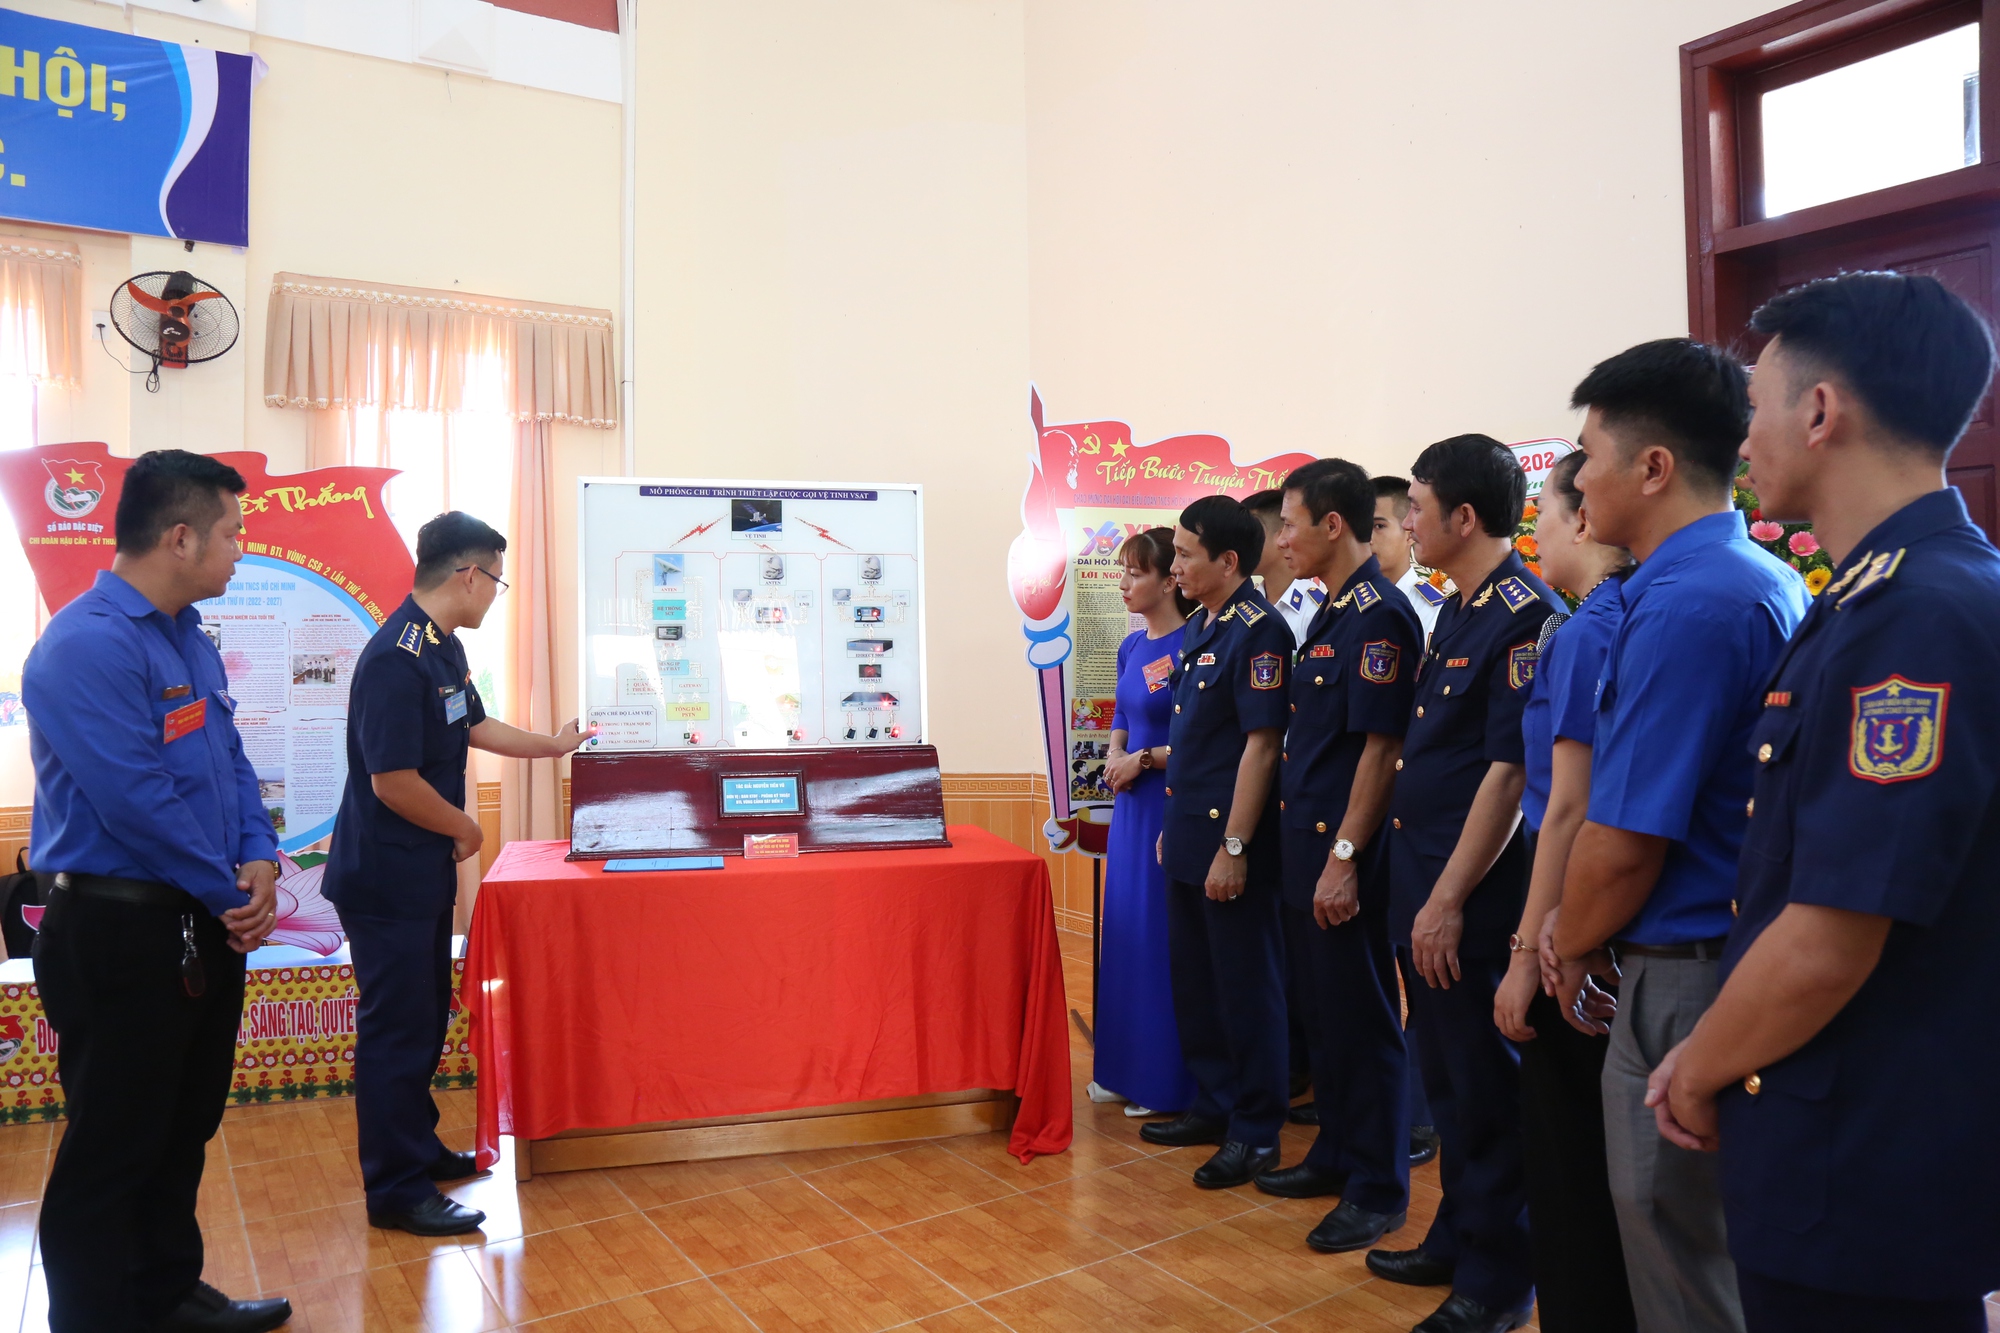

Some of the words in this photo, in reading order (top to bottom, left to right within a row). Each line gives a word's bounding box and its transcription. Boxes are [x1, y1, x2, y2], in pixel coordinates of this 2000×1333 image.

[0, 45, 127, 122] HỘI;
[712, 488, 737, 496] TRÌNH
[779, 490, 801, 499] CUỘC
[802, 491, 817, 500] GỌI
[818, 490, 829, 500] VỆ
[829, 491, 850, 499] TINH
[850, 492, 869, 500] VSAT
[1095, 456, 1137, 488] Tiếp
[1139, 456, 1186, 482] Bước
[1188, 460, 1245, 496] Truyền
[1246, 466, 1290, 492] Thố
[264, 482, 375, 519] Thắng
[247, 541, 268, 555] MINH
[269, 546, 284, 558] BTL
[286, 549, 308, 565] VÙNG
[307, 558, 325, 573] CSB
[322, 567, 332, 577] 2
[330, 570, 347, 586] LẦN
[344, 579, 363, 596] THỨ
[1077, 558, 1092, 566] ĐẠI
[1094, 557, 1111, 566] HỘI
[1081, 571, 1098, 579] LỜI
[281, 582, 296, 591] MINH
[249, 995, 288, 1040] SÁNG
[288, 1000, 320, 1045] TẠO,
